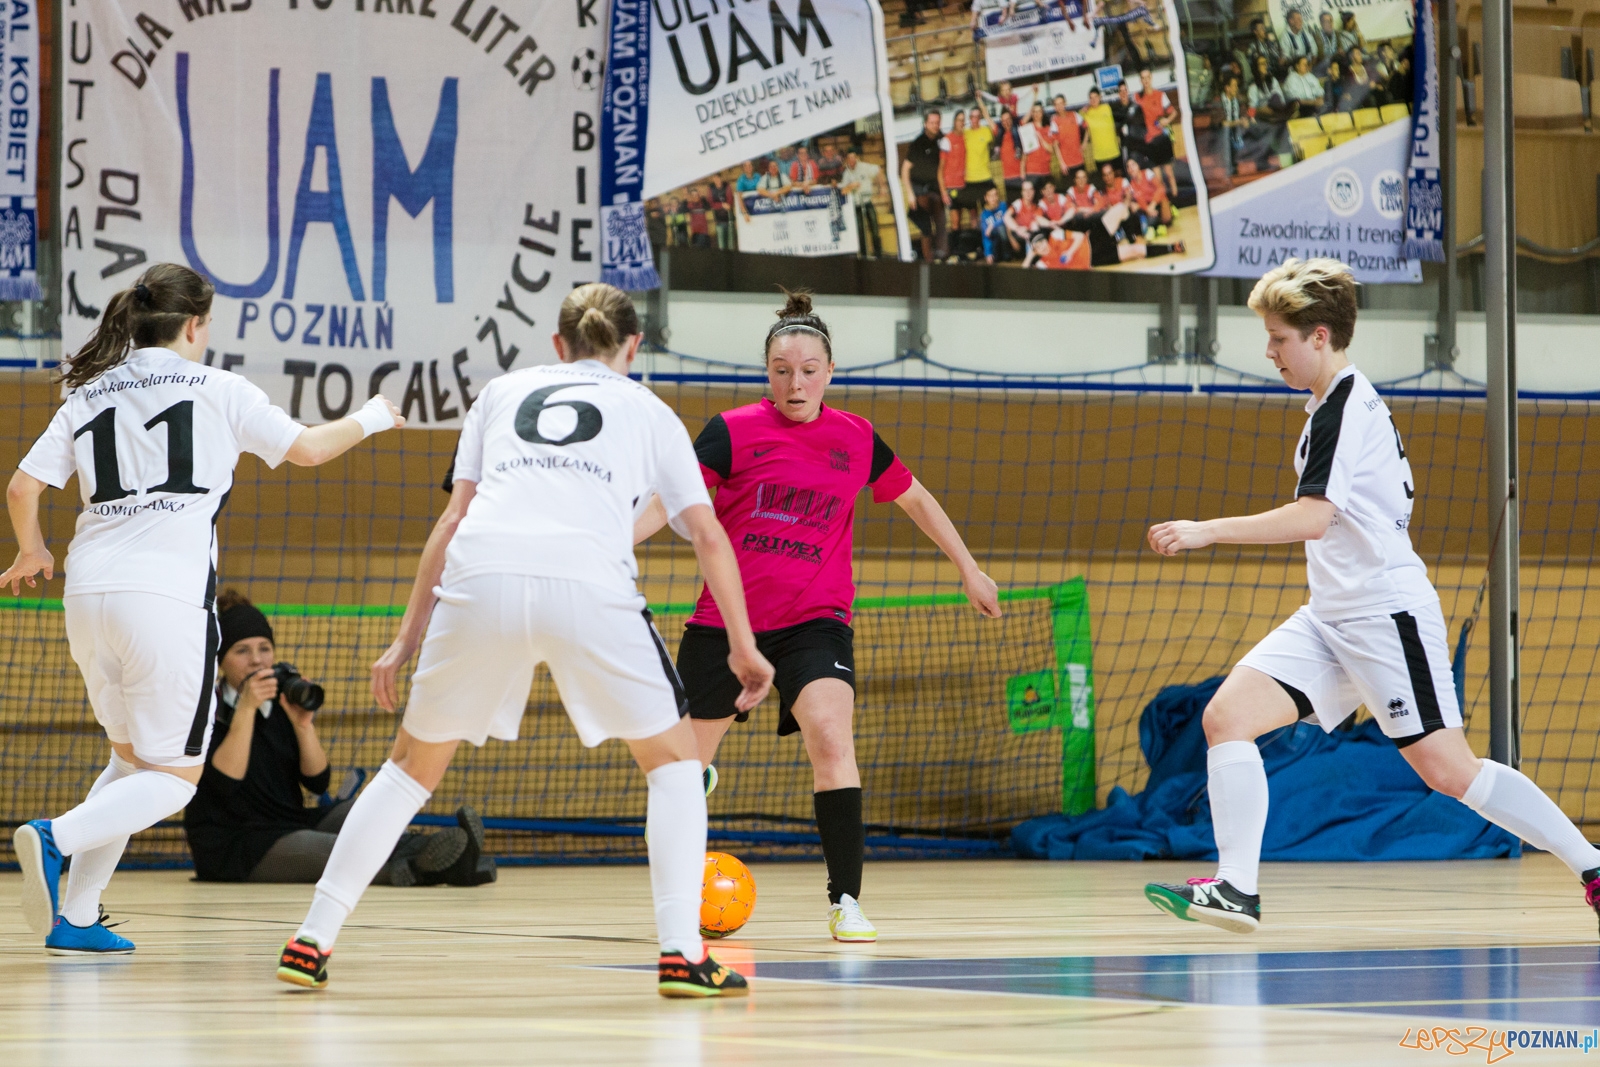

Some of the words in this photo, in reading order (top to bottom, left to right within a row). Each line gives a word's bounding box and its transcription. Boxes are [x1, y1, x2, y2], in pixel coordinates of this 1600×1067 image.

[109, 11, 174, 91] DLA
[638, 57, 649, 107] POLSKI
[666, 0, 833, 96] UAM
[7, 56, 30, 182] KOBIET
[612, 66, 643, 186] POZNAŃ
[694, 66, 810, 124] DZIĘKUJEMY,
[811, 56, 836, 81] ŻE
[698, 105, 785, 155] JESTEŚCIE
[790, 97, 803, 120] Z
[62, 0, 101, 321] UTSAL
[176, 52, 459, 303] UAM
[94, 168, 148, 280] DLA
[1238, 245, 1262, 267] KU
[1239, 217, 1341, 241] Zawodniczki
[1346, 222, 1352, 240] i
[237, 300, 394, 351] POZNAŃ
[283, 358, 354, 422] TO
[474, 203, 561, 372] ŻYCIE
[73, 400, 211, 504] 11
[513, 382, 604, 447] 6
[742, 532, 823, 561] PRIMEX
